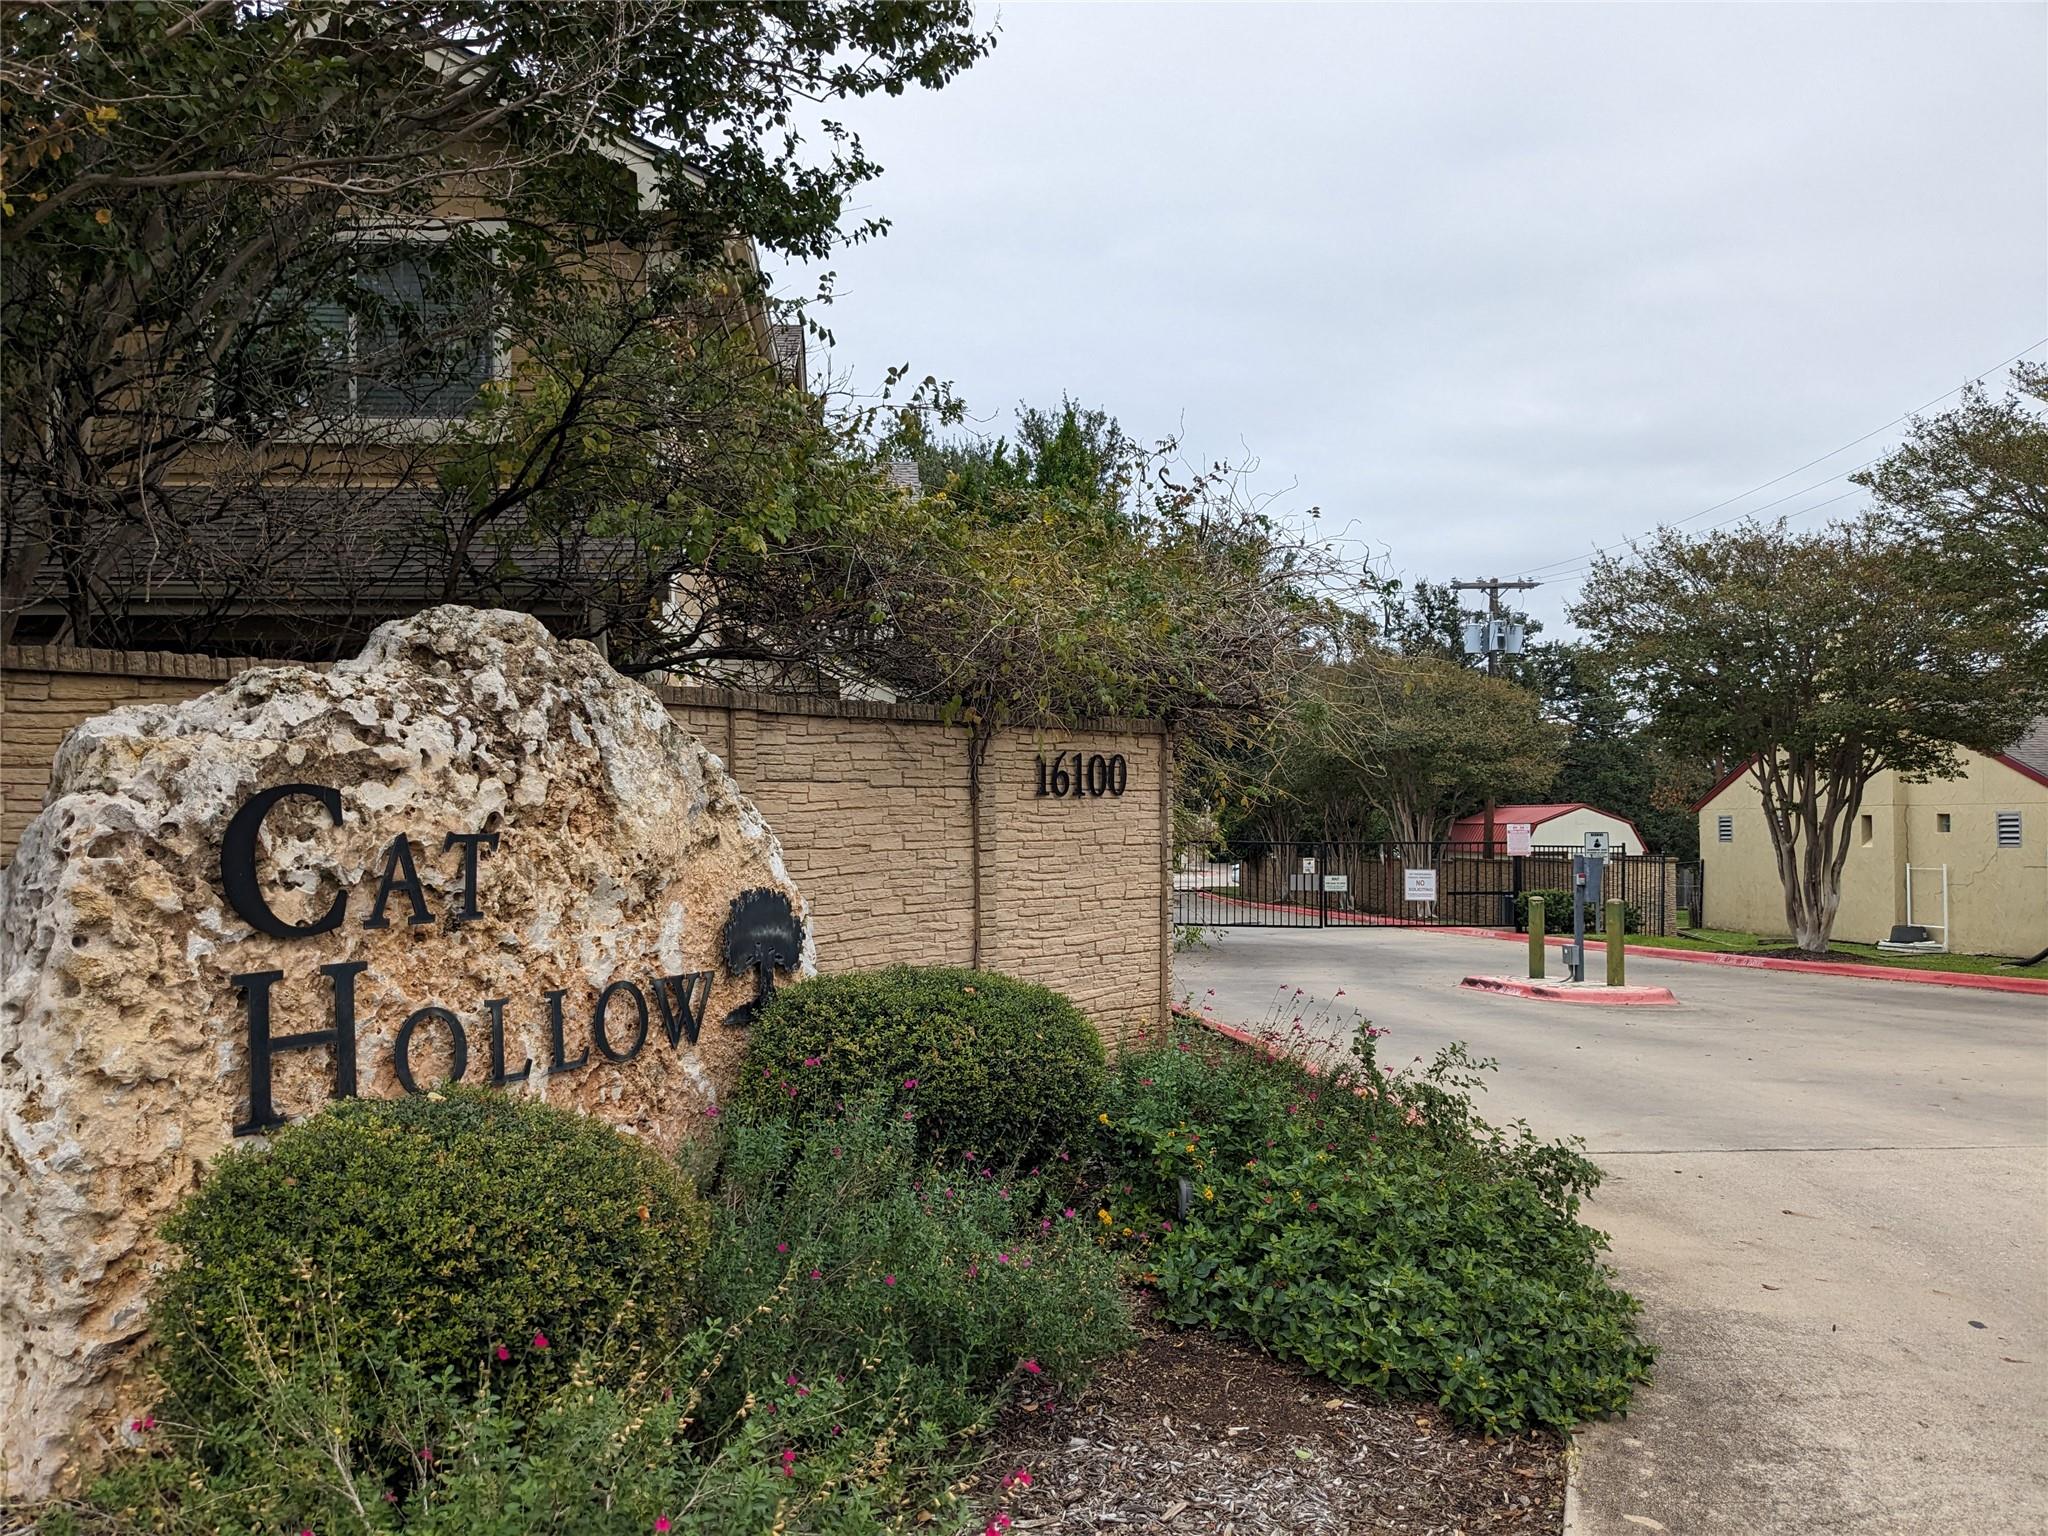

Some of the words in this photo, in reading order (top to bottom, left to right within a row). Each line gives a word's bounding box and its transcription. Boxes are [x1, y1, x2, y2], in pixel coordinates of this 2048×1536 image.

[1036, 751, 1127, 797] 16100
[220, 783, 500, 938] CAT
[231, 961, 715, 1137] HOLLOW
